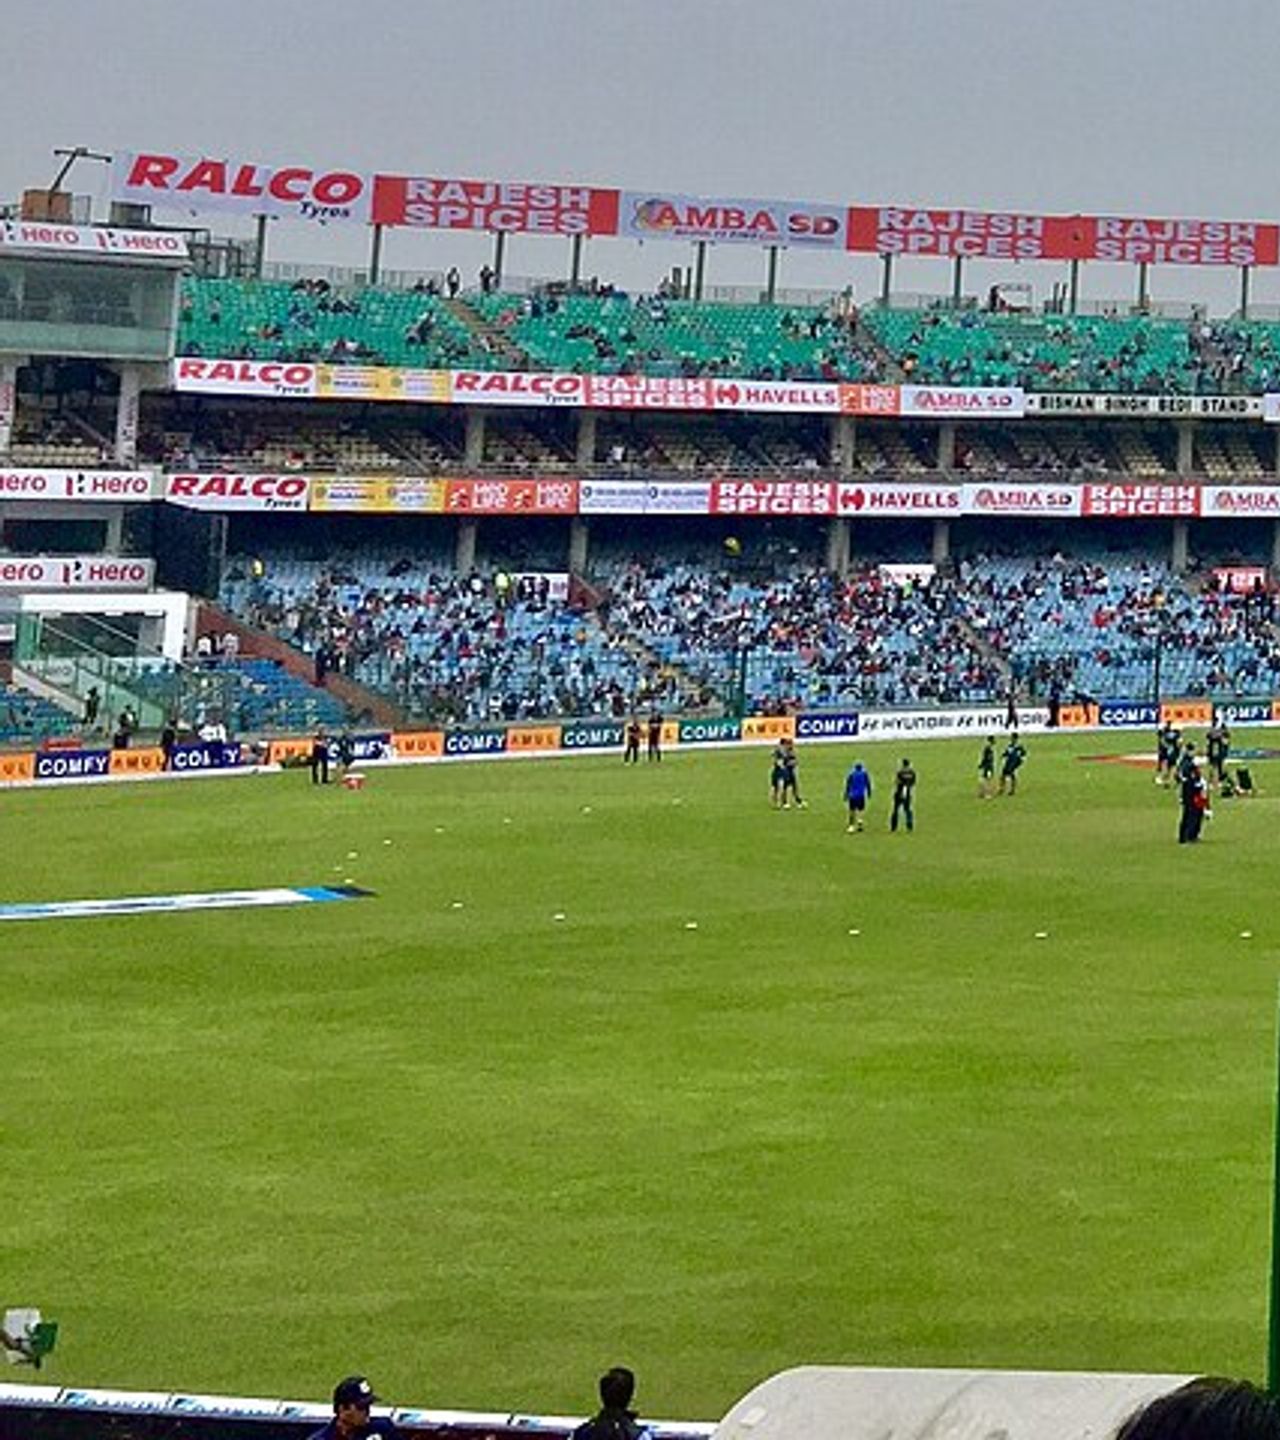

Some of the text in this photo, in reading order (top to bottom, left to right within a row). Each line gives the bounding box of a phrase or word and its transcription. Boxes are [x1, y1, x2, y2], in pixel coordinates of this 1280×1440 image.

[126, 155, 363, 205] RALCO
[405, 179, 590, 209] RAJESH
[300, 202, 350, 218] Tyres
[402, 204, 590, 234] SPICES
[652, 201, 840, 236] AMBA SD
[879, 208, 1043, 237] RAJESH
[1096, 217, 1257, 243] RAJESH
[21, 227, 80, 245] Hero
[123, 234, 179, 251] Hero
[876, 231, 1043, 259] SPICES
[1094, 239, 1257, 265] SPICES
[179, 361, 314, 384] RALCO
[454, 373, 581, 394] RALCO
[591, 376, 706, 392] RAJESH
[591, 392, 706, 408] SPICES
[745, 388, 837, 405] HAVELLS
[1039, 396, 1096, 411] BISHAN
[1201, 398, 1249, 413] STAND
[91, 476, 149, 494] Hero
[170, 476, 308, 497] RALCO
[719, 483, 830, 497] RAJESH
[1091, 486, 1195, 500] RAJESH
[717, 498, 830, 512] SPICES
[869, 491, 959, 508] HAVELLS
[1091, 500, 1195, 515] SPICES
[0, 562, 43, 581] ero
[89, 564, 146, 582] Hero
[1101, 706, 1158, 723] COMFY
[680, 724, 739, 741] COMFY
[799, 718, 857, 735] COMFY
[447, 734, 505, 752] COMFY
[563, 728, 623, 746] COMFY
[38, 757, 108, 776] COMFY
